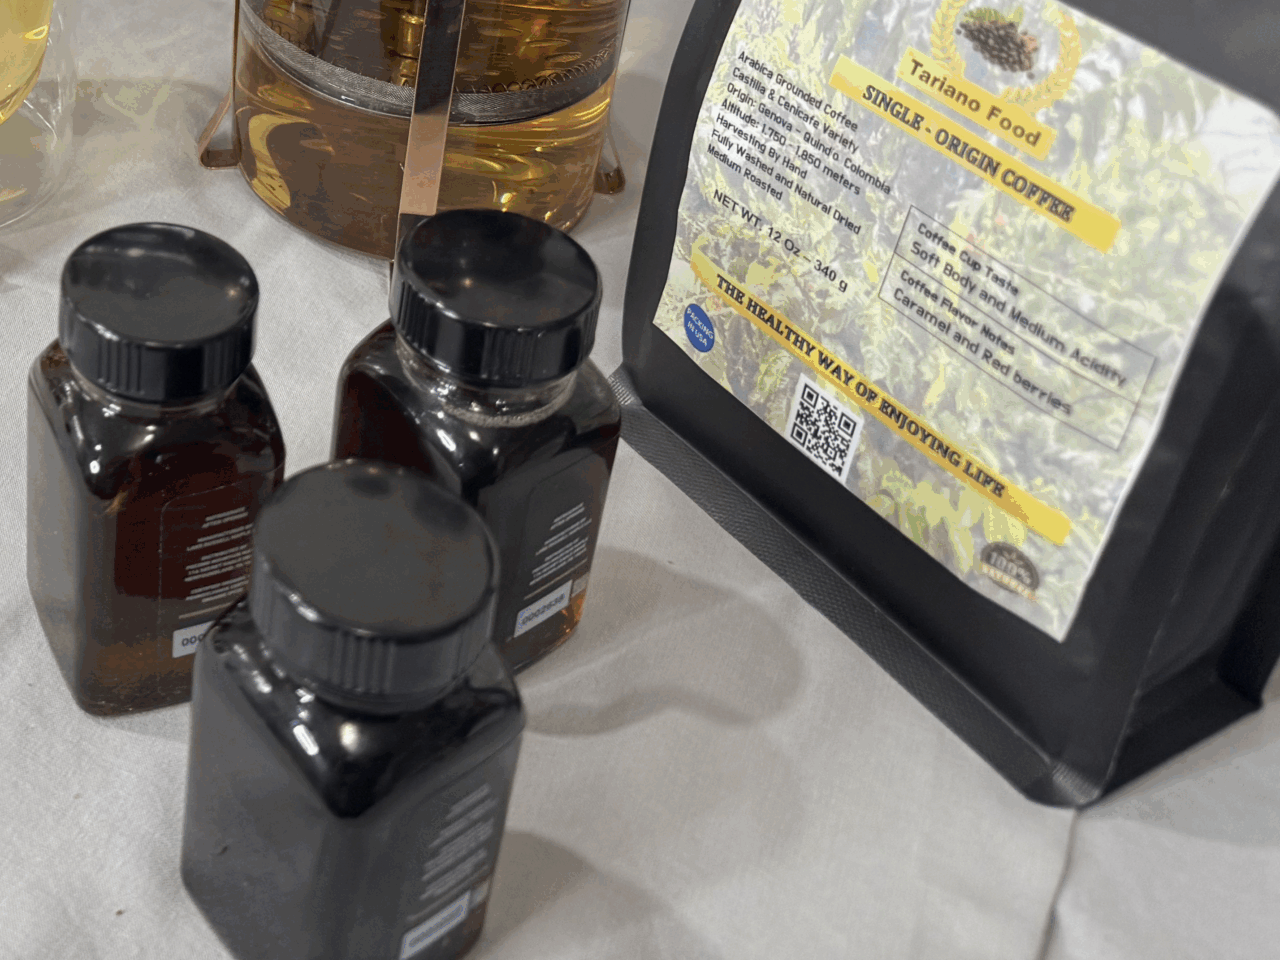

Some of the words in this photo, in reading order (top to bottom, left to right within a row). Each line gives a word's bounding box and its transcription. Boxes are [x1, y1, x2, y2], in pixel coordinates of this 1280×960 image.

[733, 67, 766, 95] Castilla
[768, 89, 775, 101] &
[823, 123, 859, 154] Variety
[738, 51, 773, 79] Arabica
[776, 73, 822, 109] Grounded
[824, 103, 858, 132] Coffee
[910, 59, 980, 113] Tariano
[986, 105, 1042, 147] Food
[707, 144, 742, 173] Medium
[744, 169, 783, 200] Roasted
[712, 129, 734, 151] Fully
[736, 144, 774, 176] Washed
[775, 173, 793, 189] and
[794, 184, 831, 215] Natural
[833, 209, 861, 235] Dried
[716, 113, 767, 153] Harvesting
[769, 148, 781, 163] By
[782, 158, 808, 179] Hand
[721, 98, 760, 128] Altitude:
[762, 123, 787, 146] 1.750
[796, 145, 821, 169] 1.850
[823, 165, 861, 195] meters
[727, 83, 756, 107] Origin:
[758, 102, 793, 132] Genova
[844, 158, 891, 195] Colombia
[862, 84, 925, 132] SINGLE
[934, 128, 1001, 178] ORIGIN
[1001, 169, 1076, 223] COFFEE
[713, 189, 740, 212] NET
[741, 207, 762, 231] WT.
[768, 227, 782, 243] 12
[784, 239, 800, 258] Oz
[814, 260, 837, 282] 340
[839, 280, 848, 292] g
[917, 223, 956, 255] Coffee
[959, 250, 981, 272] Cup
[985, 267, 1019, 297] Taste
[686, 307, 714, 339] PACKING
[687, 321, 695, 332] IN
[695, 329, 708, 347] USA
[893, 287, 951, 335] Caramel
[953, 330, 979, 355] and
[981, 349, 1011, 377] Red
[1013, 371, 1073, 416] berries
[900, 270, 938, 302] Coffee
[940, 298, 978, 329] Flavor
[980, 324, 1016, 356] Notes
[910, 242, 940, 268] Soft
[943, 262, 977, 295] Body
[979, 289, 1006, 313] and
[1009, 306, 1066, 354] Medium
[1070, 348, 1126, 389] Acidity
[717, 273, 745, 305] THE
[746, 298, 815, 357] HEALTHY
[817, 350, 854, 387] WAY
[856, 381, 879, 403] OF
[878, 398, 961, 467] ENJOYING
[962, 461, 1007, 498] LIFE
[989, 550, 1032, 585] 100%
